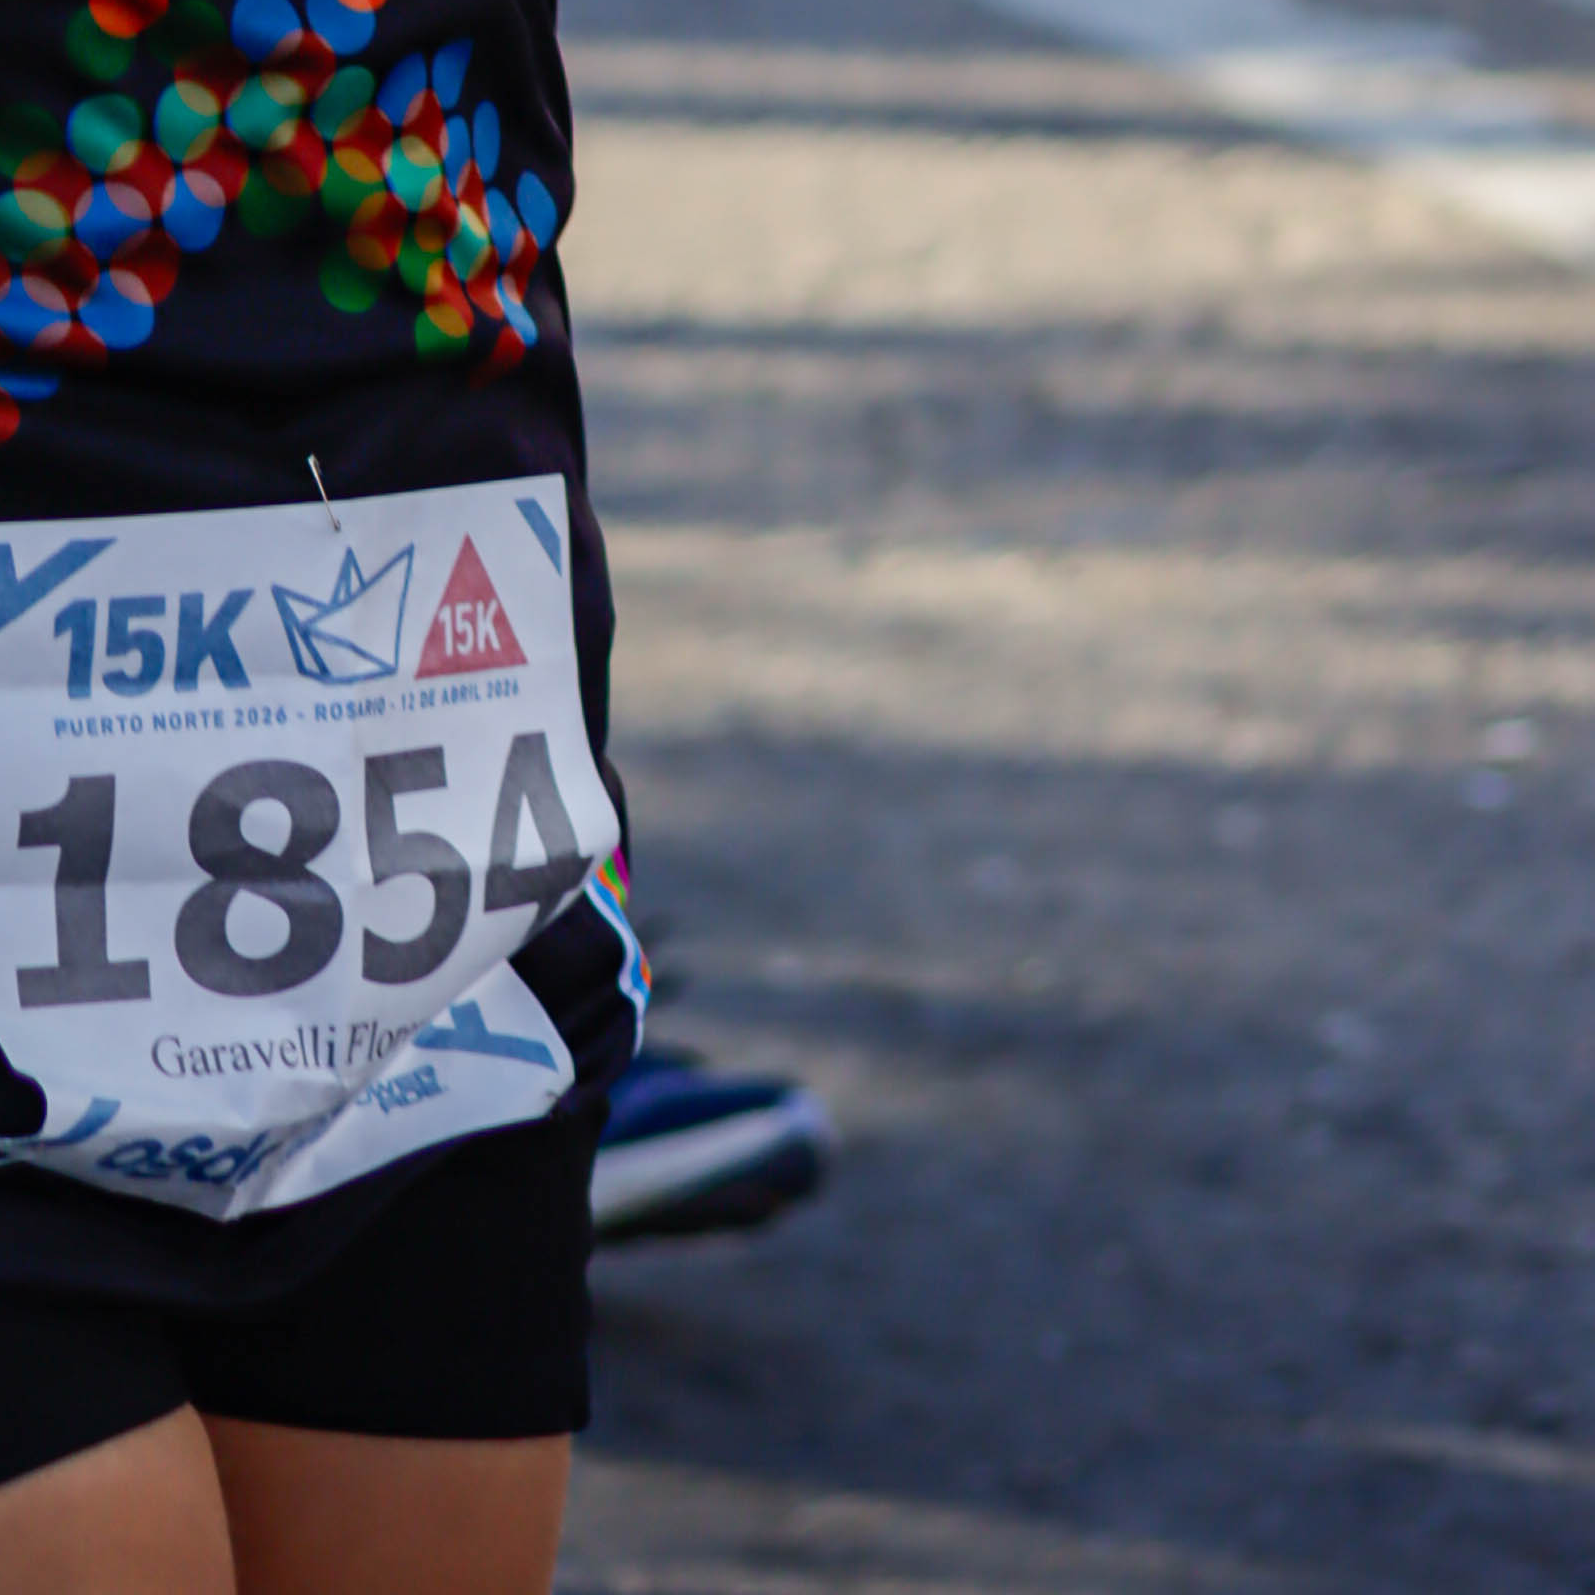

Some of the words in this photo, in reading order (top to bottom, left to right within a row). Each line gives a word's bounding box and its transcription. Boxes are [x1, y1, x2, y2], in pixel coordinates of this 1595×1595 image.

[54, 588, 255, 699] 15K
[438, 598, 502, 657] 15K
[54, 714, 144, 737] PUERTO
[153, 710, 225, 731] NORTE
[234, 705, 288, 727] 2026
[314, 696, 387, 722] ROSARIO
[400, 694, 415, 713] 12
[420, 689, 436, 709] DE
[441, 684, 482, 705] ABRIL
[486, 679, 520, 700] 2026
[15, 731, 593, 1008] 1854
[150, 1024, 336, 1079] Garavelli
